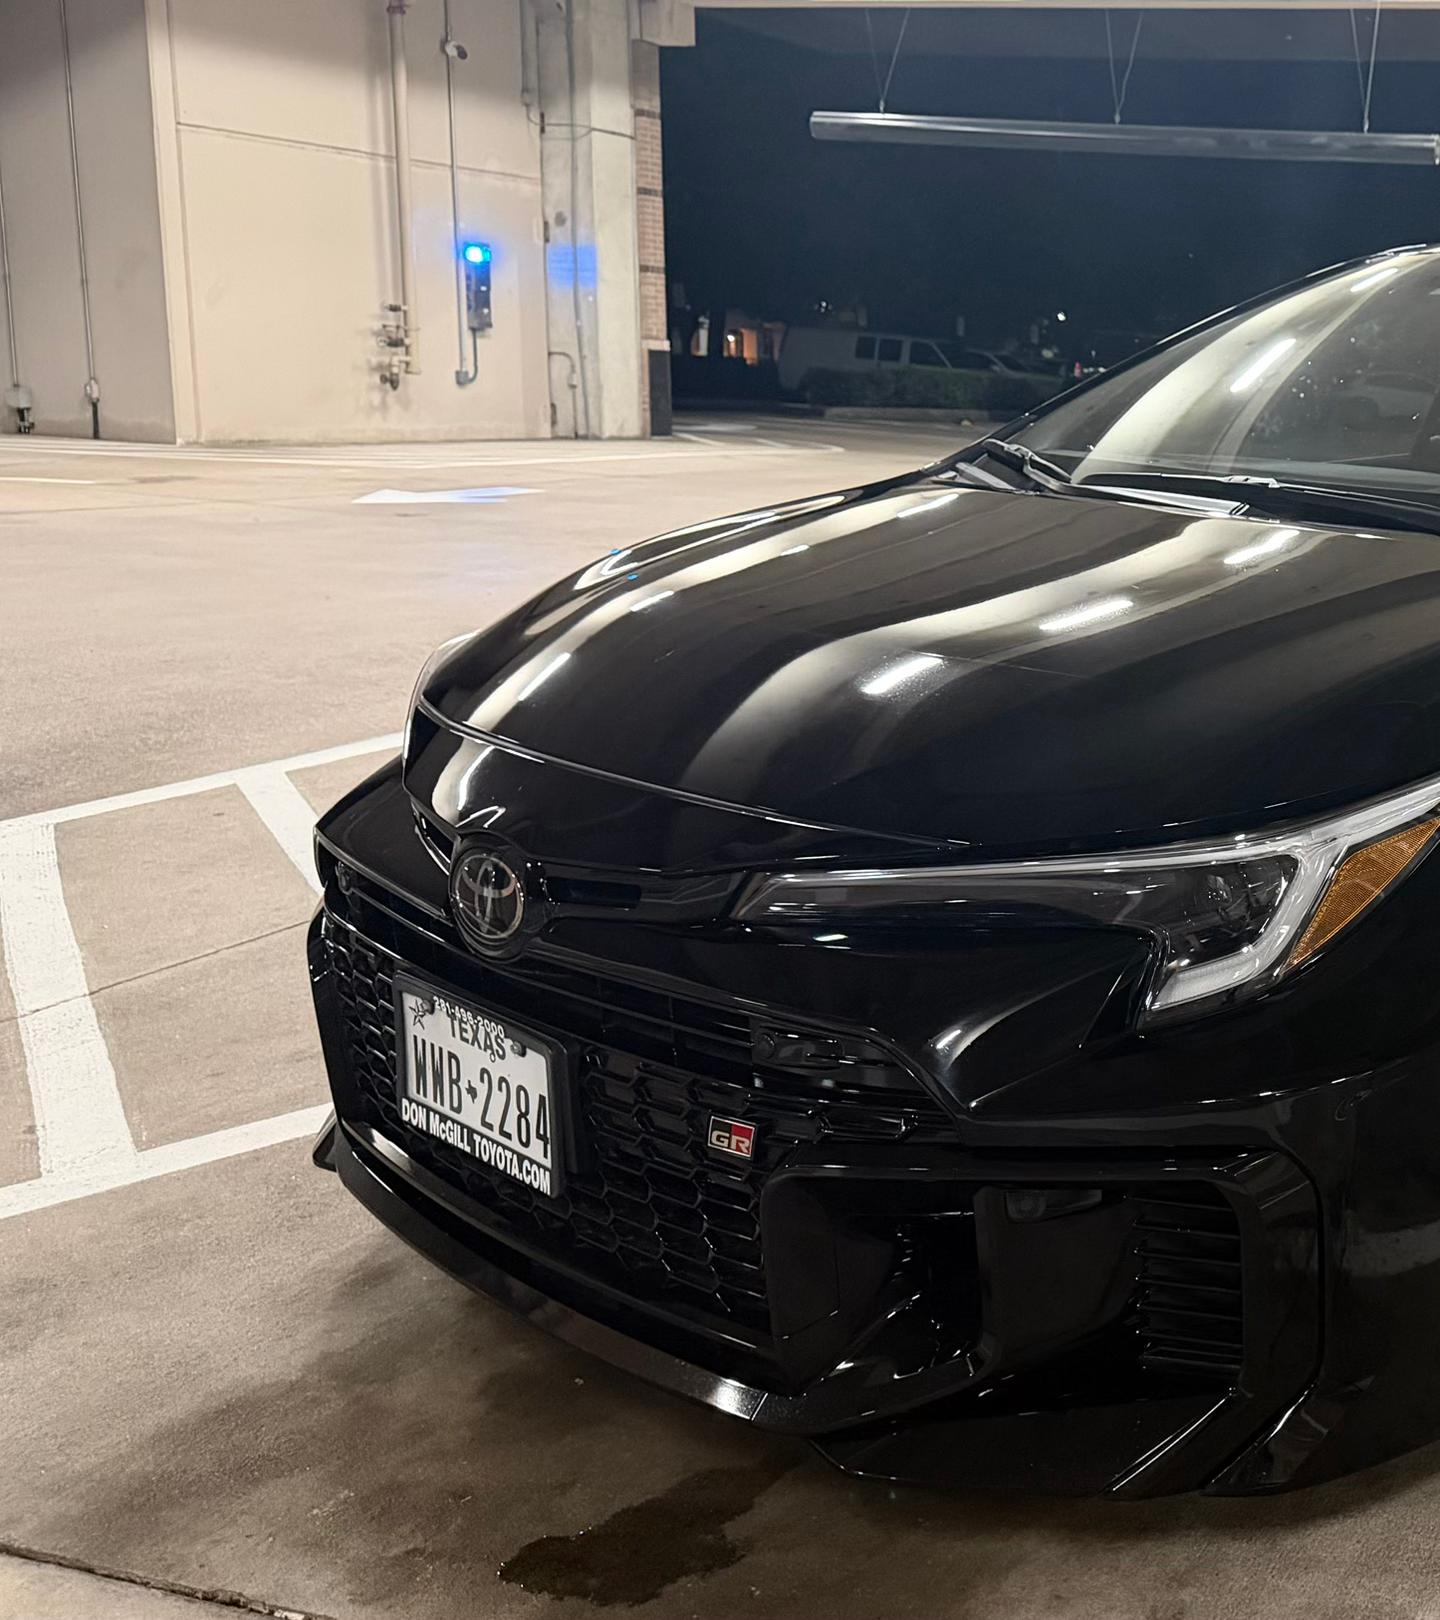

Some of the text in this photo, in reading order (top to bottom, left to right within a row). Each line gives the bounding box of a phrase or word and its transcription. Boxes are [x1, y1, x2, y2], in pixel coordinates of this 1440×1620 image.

[447, 1013, 506, 1060] TEXAS
[413, 1034, 549, 1159] WWB 2284
[402, 1098, 550, 1195] DON McGILL TOYOTA.COM
[711, 1130, 751, 1153] GR
